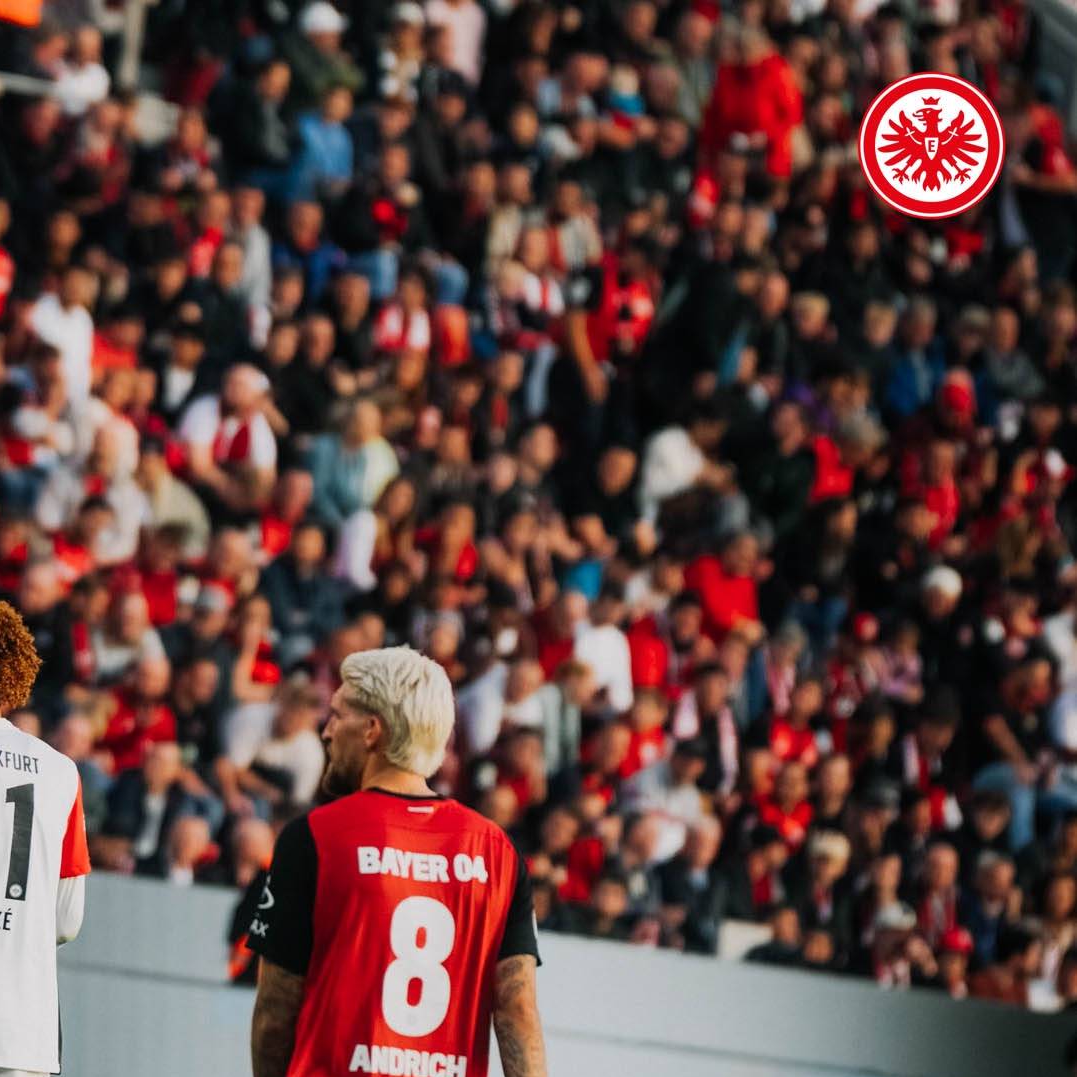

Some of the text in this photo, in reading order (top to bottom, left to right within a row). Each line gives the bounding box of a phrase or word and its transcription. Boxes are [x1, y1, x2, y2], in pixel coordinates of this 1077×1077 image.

[357, 846, 489, 884] BAYER 04
[381, 895, 456, 1037] 8
